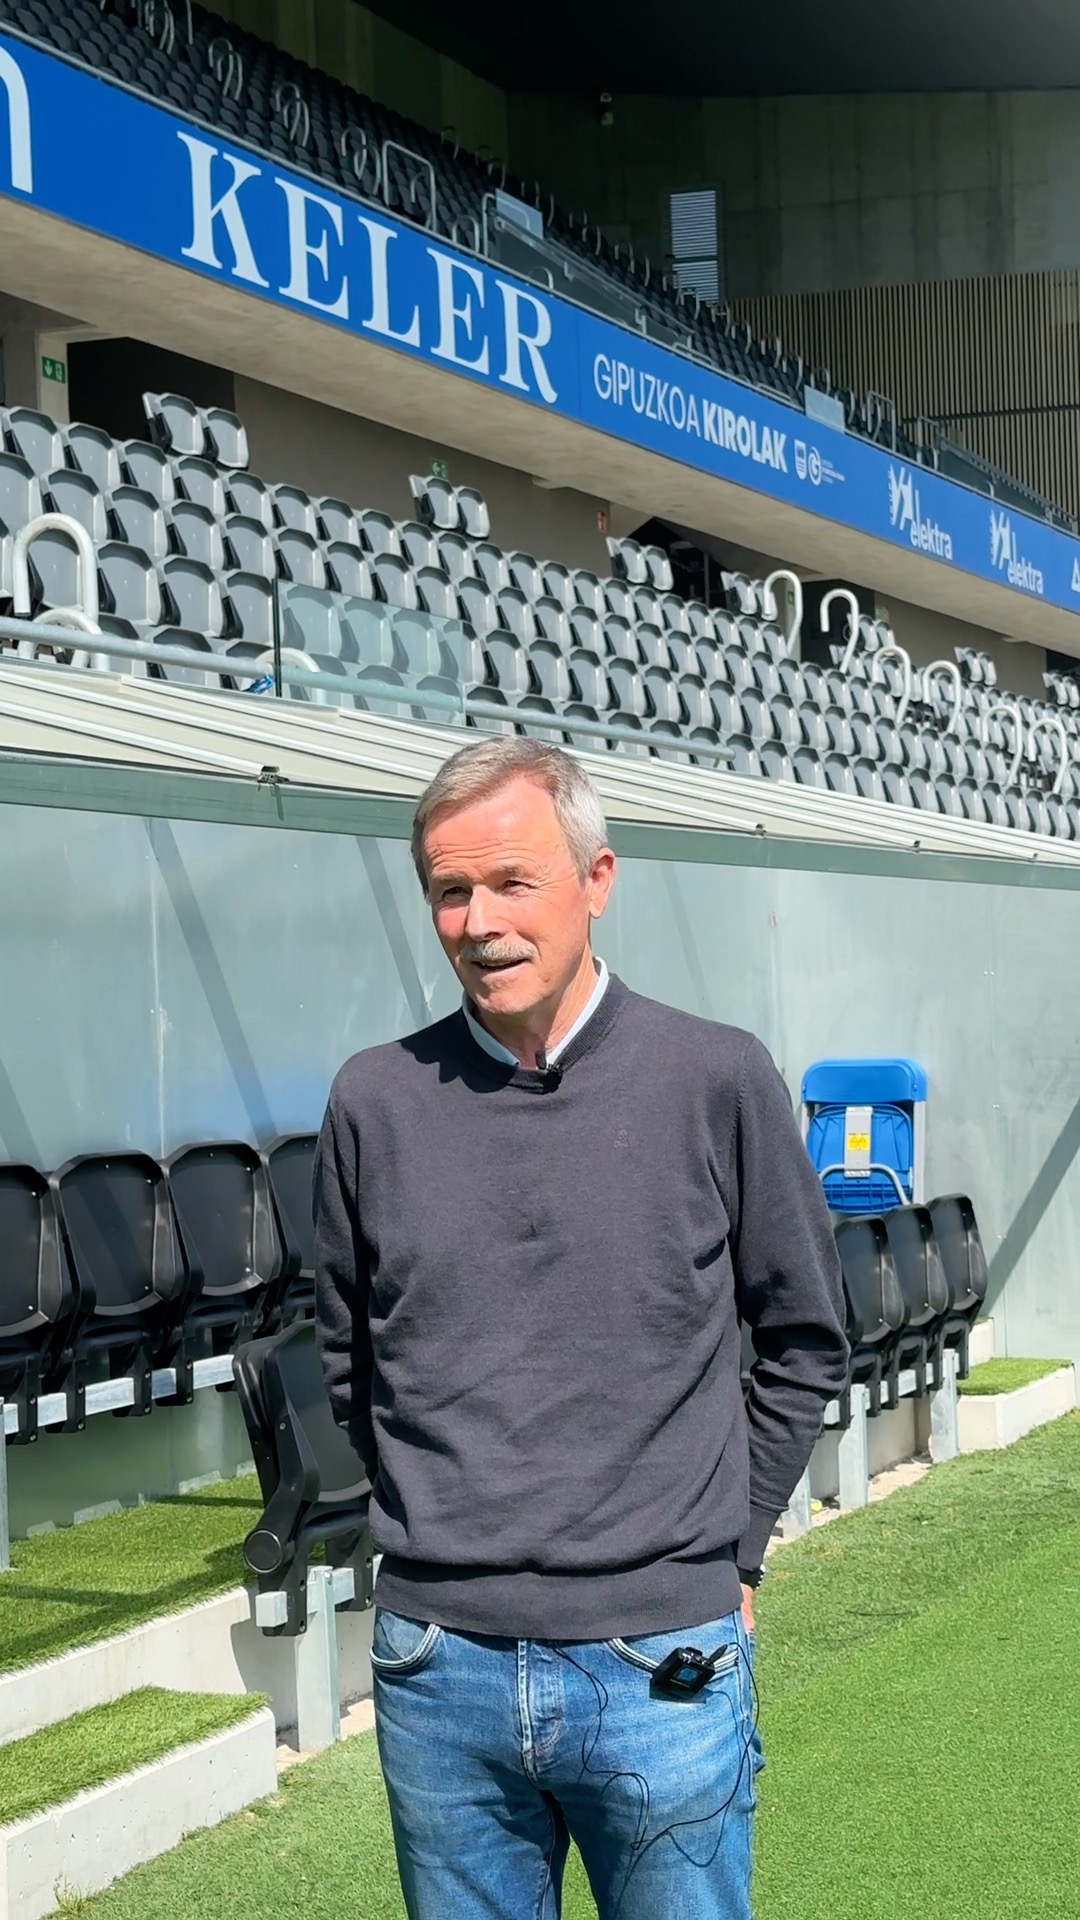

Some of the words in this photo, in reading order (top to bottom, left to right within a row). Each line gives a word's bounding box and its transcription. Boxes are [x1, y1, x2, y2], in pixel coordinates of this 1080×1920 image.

[177, 131, 558, 404] KELER
[910, 488, 953, 560] elektra
[1007, 531, 1043, 594] elektra
